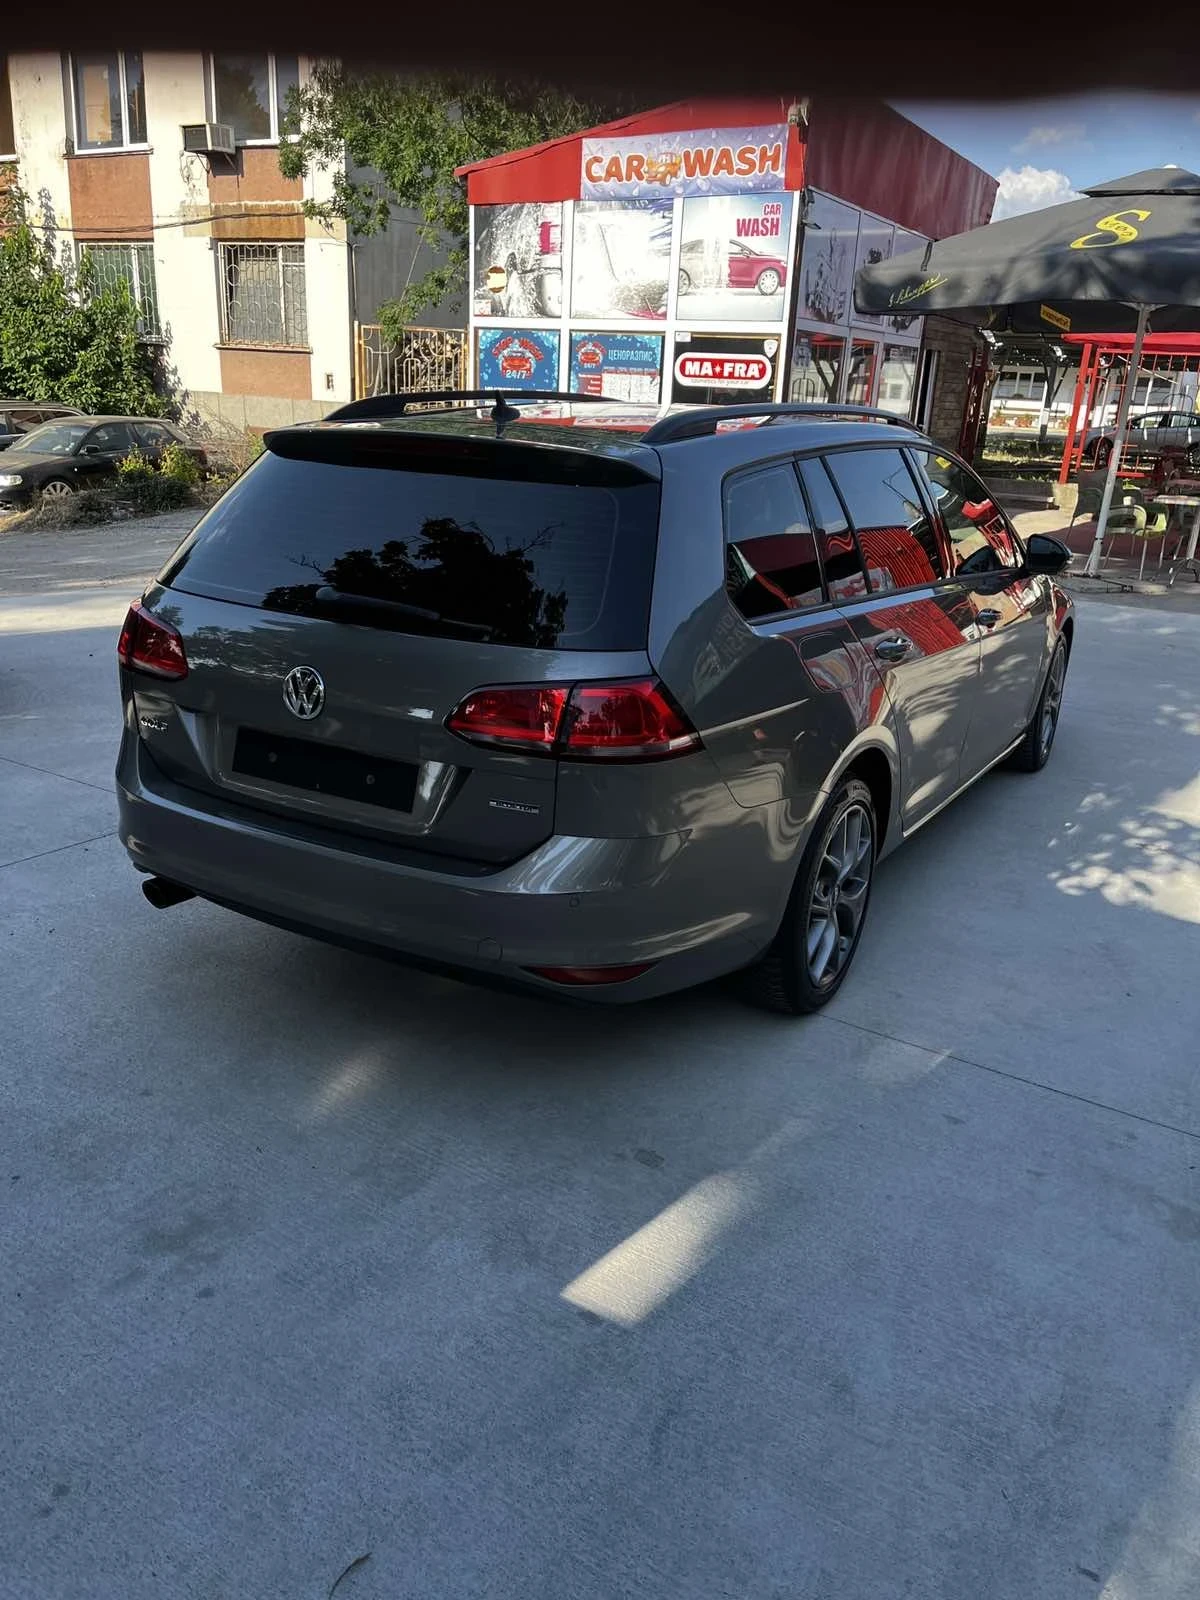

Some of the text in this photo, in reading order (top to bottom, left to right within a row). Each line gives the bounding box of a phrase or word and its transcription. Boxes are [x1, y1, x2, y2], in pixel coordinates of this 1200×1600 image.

[585, 143, 782, 184] CAR WASH
[763, 204, 781, 216] CAR
[736, 218, 780, 237] WASH
[505, 369, 527, 379] 24/7
